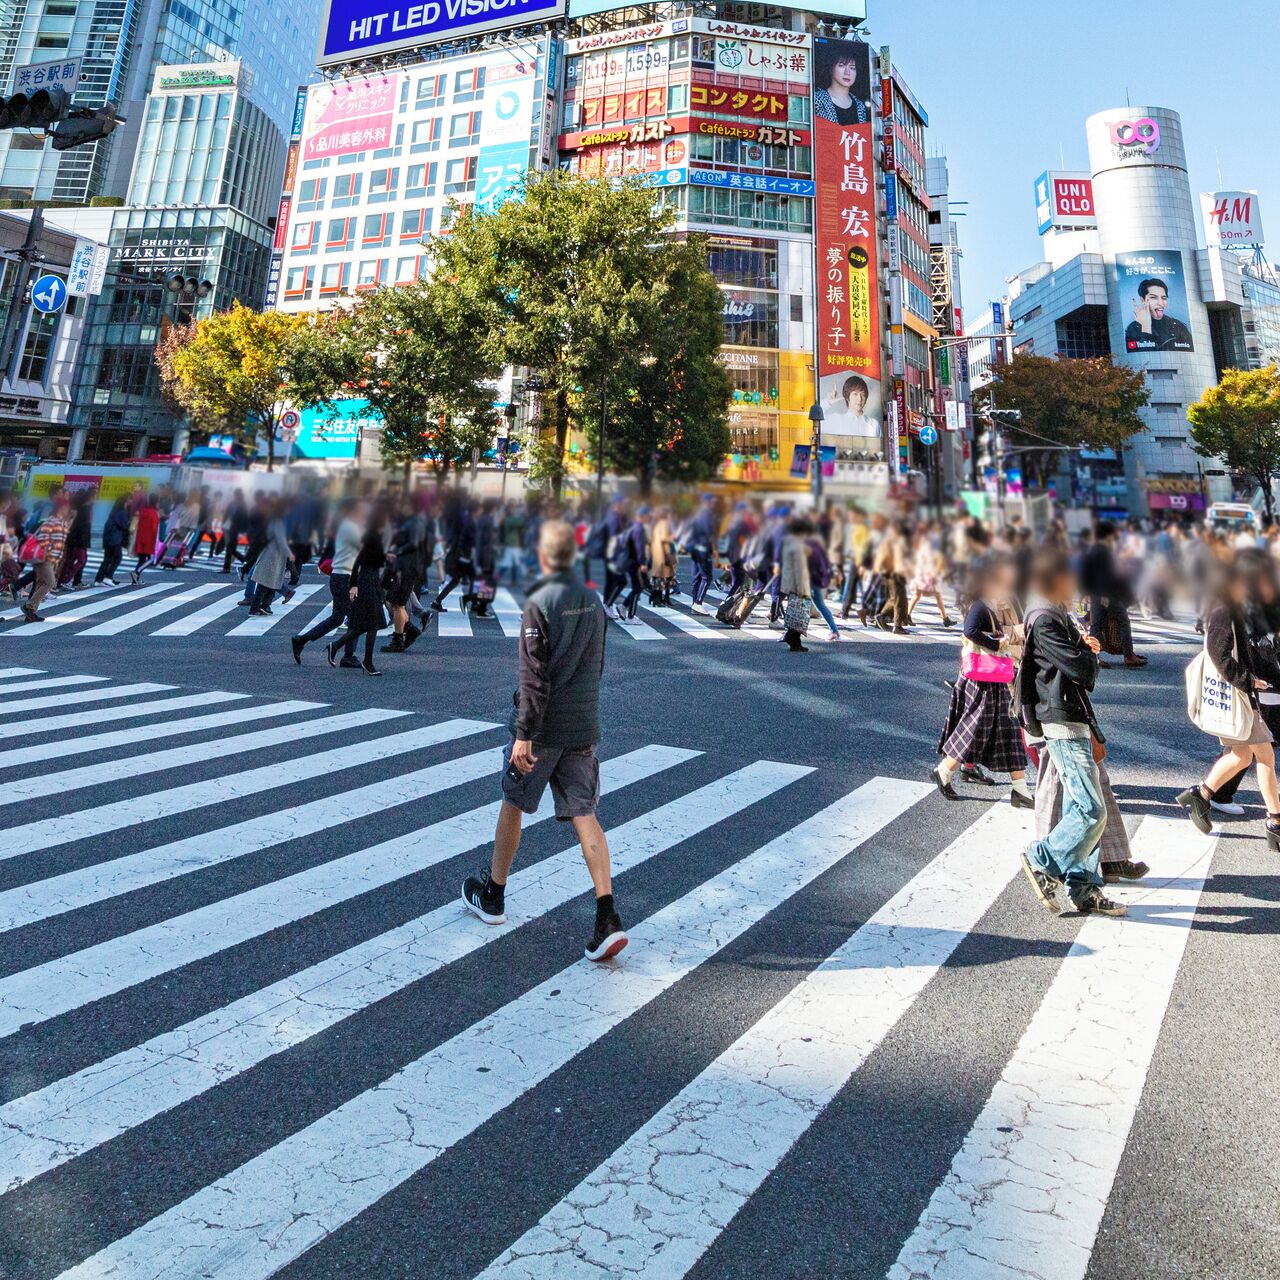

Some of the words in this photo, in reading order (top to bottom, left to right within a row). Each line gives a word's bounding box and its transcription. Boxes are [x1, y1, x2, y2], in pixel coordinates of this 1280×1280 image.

[348, 17, 389, 42] HIT
[391, 6, 442, 34] LED
[706, 20, 807, 45] しゃぶしゃぶバイキング
[576, 24, 664, 51] しゃぶしゃぶバイキング
[747, 47, 807, 73] しゃぶ葉
[19, 63, 77, 87] 渋谷駅前
[347, 83, 393, 102] 品川スキン
[583, 88, 666, 120] プライス
[691, 86, 785, 112] コンタクト
[346, 97, 387, 114] クリニック
[315, 126, 388, 154] 品川美容外科
[629, 121, 672, 144] ガスト
[699, 122, 756, 139] Caféレストラン
[756, 125, 803, 146] ガスト
[1103, 117, 1161, 155] 109
[606, 144, 658, 173] ガスト
[838, 130, 869, 195] 竹島
[694, 170, 724, 183] AEON
[730, 174, 814, 194] 英会話イーオン
[1058, 182, 1088, 197] UNI
[1060, 198, 1091, 214] QLO
[1208, 196, 1251, 226] H&M
[840, 205, 870, 238] 宏
[114, 248, 167, 259] MARK
[171, 247, 217, 258] CITY
[141, 237, 190, 246] SHIBUYA
[75, 245, 95, 293] 渋谷駅前
[826, 242, 847, 353] 「夢の振り子」
[826, 352, 873, 368] 好評発売中
